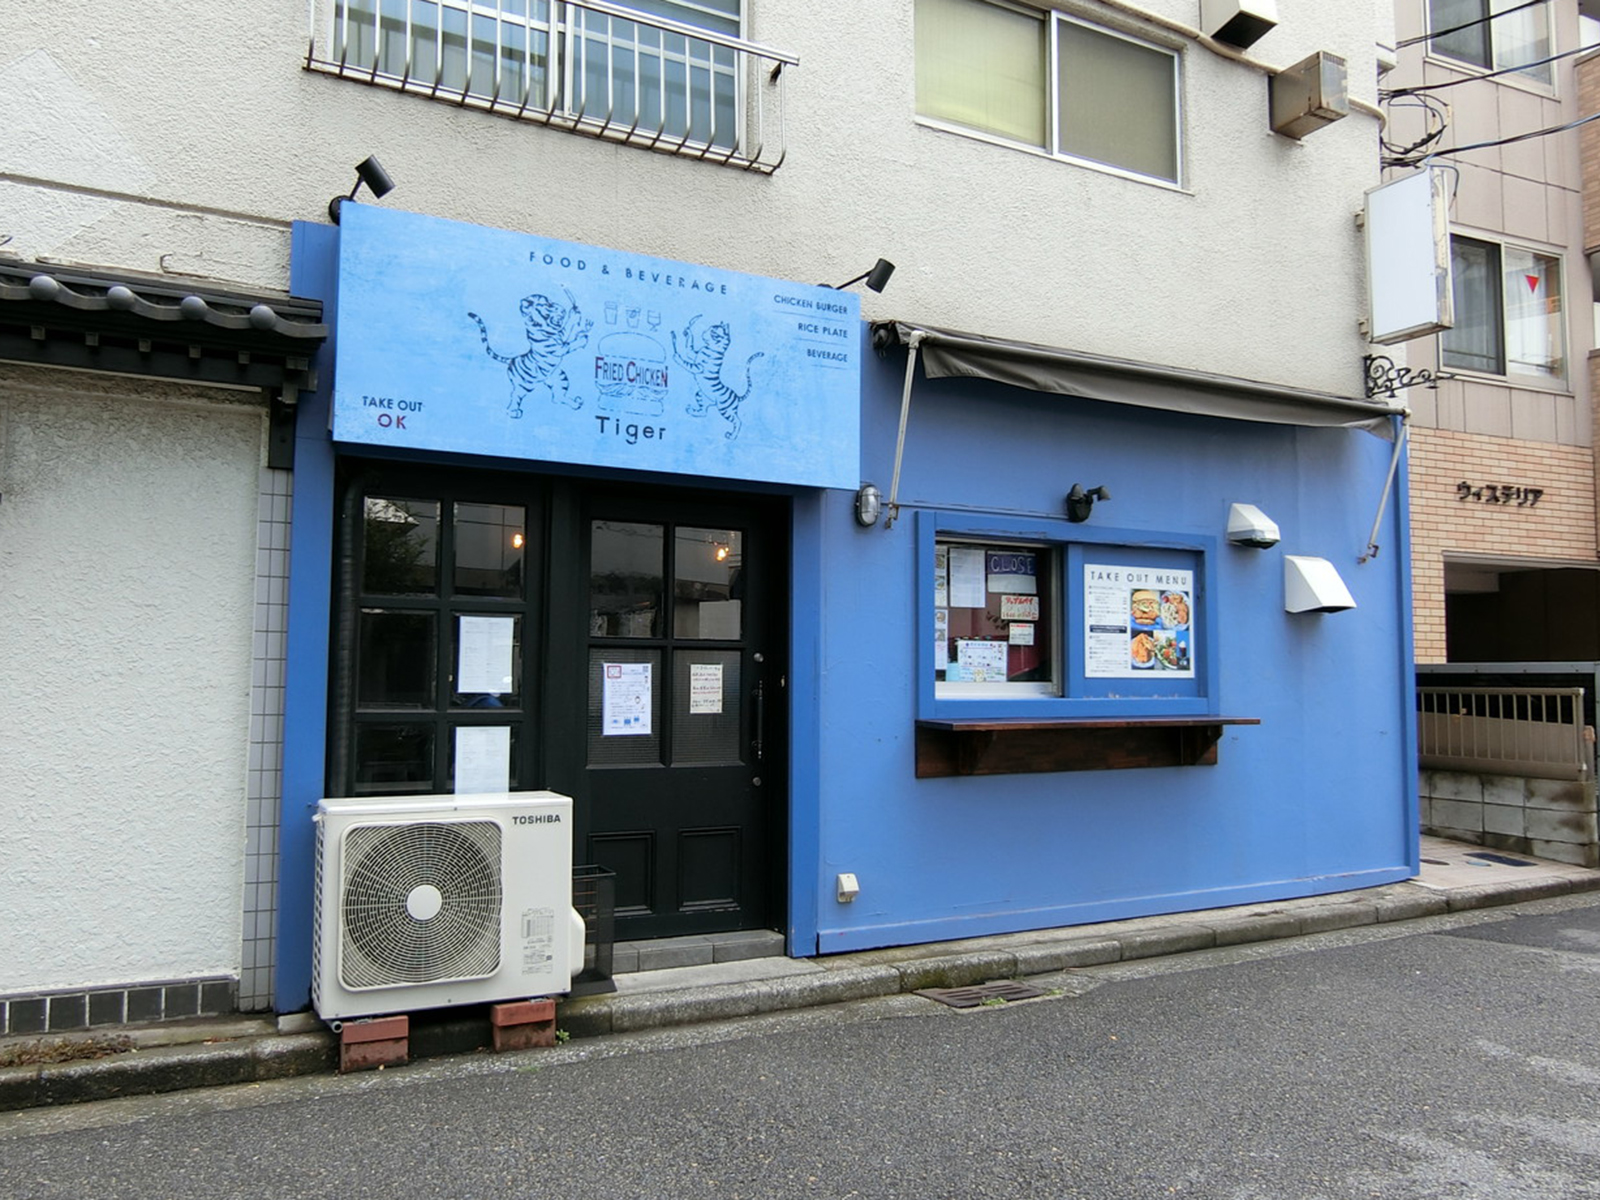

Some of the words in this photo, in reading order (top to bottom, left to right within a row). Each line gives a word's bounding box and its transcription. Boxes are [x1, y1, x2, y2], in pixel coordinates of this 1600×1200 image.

[529, 252, 587, 271] FOOD
[600, 264, 611, 275] &
[625, 268, 728, 295] BEVERAGE
[773, 294, 813, 309] CHICKEN
[816, 301, 848, 315] BURGER
[797, 322, 819, 334] RICE
[822, 326, 848, 338] PLATE
[807, 348, 848, 363] BEVERAGE
[362, 396, 394, 410] TAKE
[397, 399, 423, 412] OUT
[377, 413, 407, 430] OK
[595, 415, 666, 445] Tiger
[1457, 481, 1544, 507] ウィステリア
[990, 555, 1034, 575] CLOSE
[1090, 571, 1119, 582] TAKE
[1126, 573, 1149, 583] OUT
[1155, 575, 1187, 585] MENU
[512, 814, 561, 826] TOSHIBA
